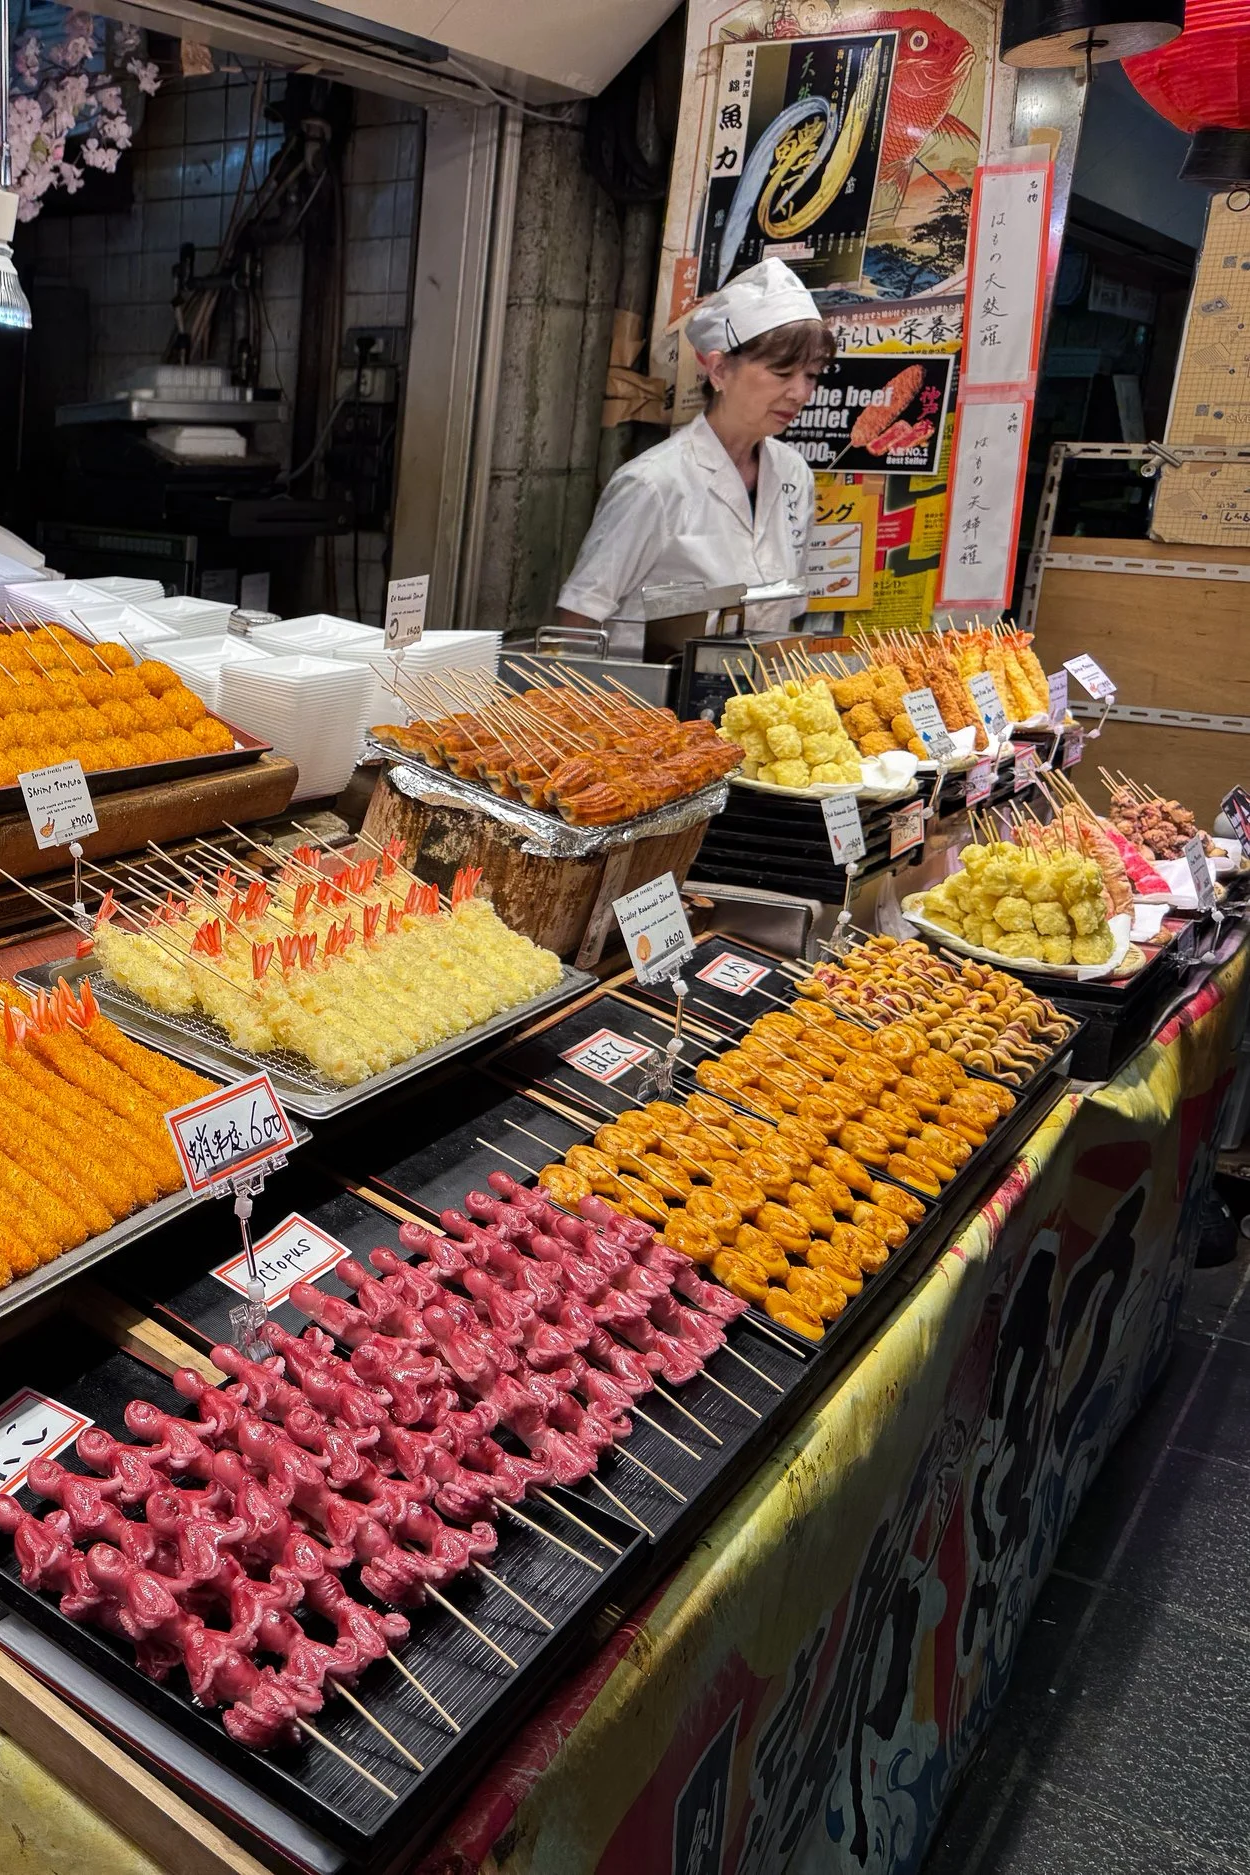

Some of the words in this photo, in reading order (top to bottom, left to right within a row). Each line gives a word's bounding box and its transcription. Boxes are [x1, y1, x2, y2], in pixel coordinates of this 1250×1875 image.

[805, 385, 843, 407] obe
[845, 385, 894, 408] beef
[27, 784, 52, 798] Shrimp
[619, 909, 638, 925] Scallop
[664, 928, 685, 948] ¥600
[576, 1040, 634, 1074] ほたて
[250, 1100, 282, 1145] 600
[256, 1238, 311, 1287] ctopus
